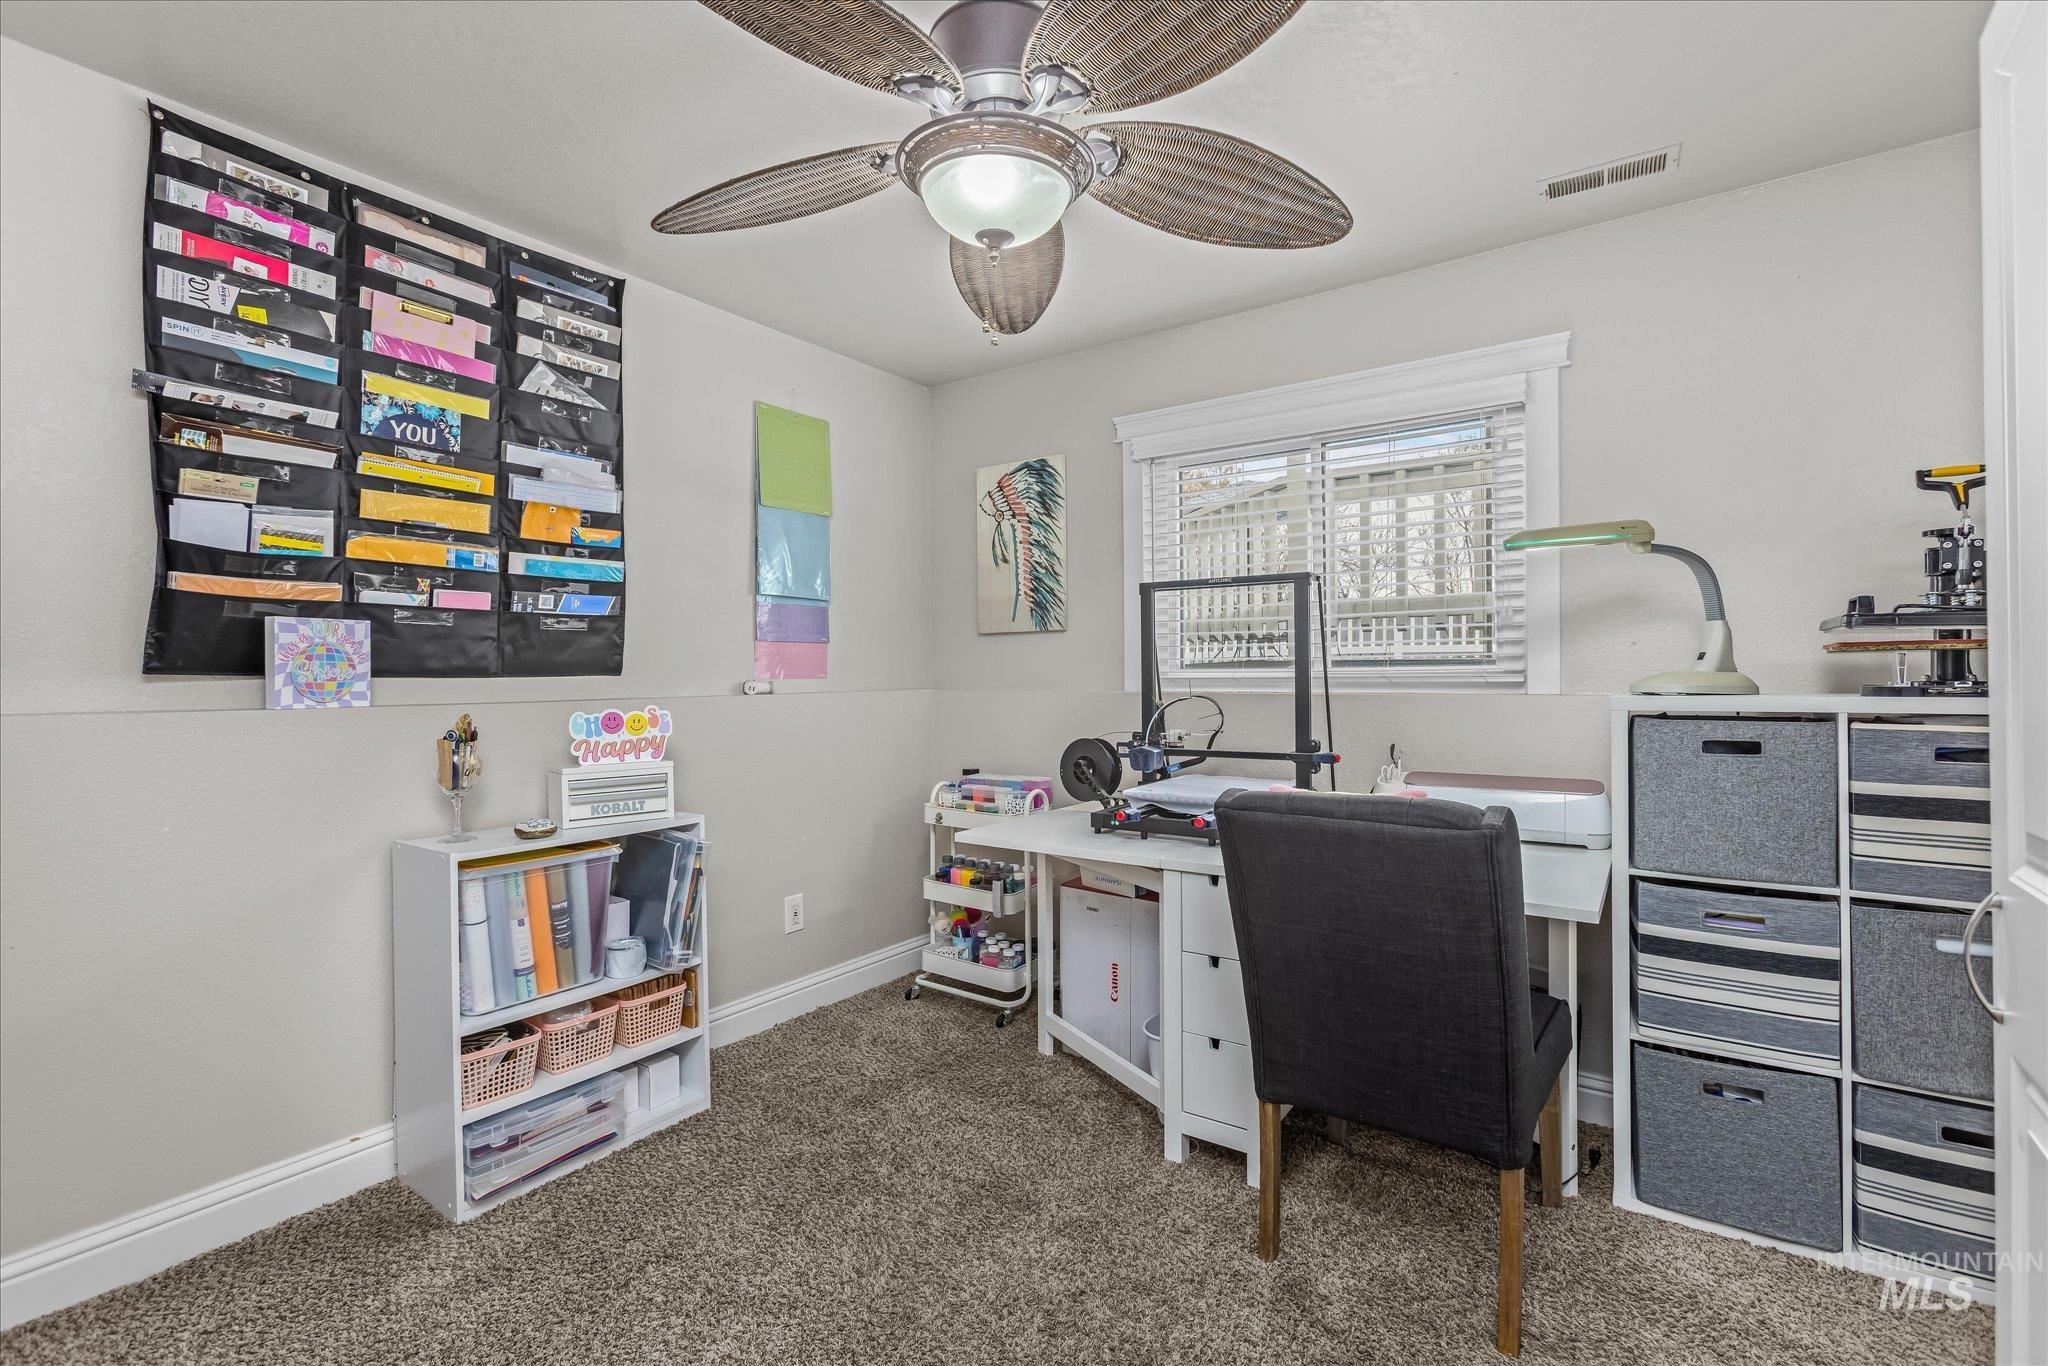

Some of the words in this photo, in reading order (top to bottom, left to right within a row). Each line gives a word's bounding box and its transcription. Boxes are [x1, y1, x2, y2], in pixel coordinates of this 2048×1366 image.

[188, 277, 211, 309] DIY
[166, 322, 190, 333] SPIN
[389, 419, 437, 445] YOU
[306, 621, 340, 638] YOUR
[571, 707, 671, 739] CHOOSE
[574, 735, 666, 763] Happy
[590, 800, 646, 816] KOBALT
[1110, 962, 1119, 1003] Canon
